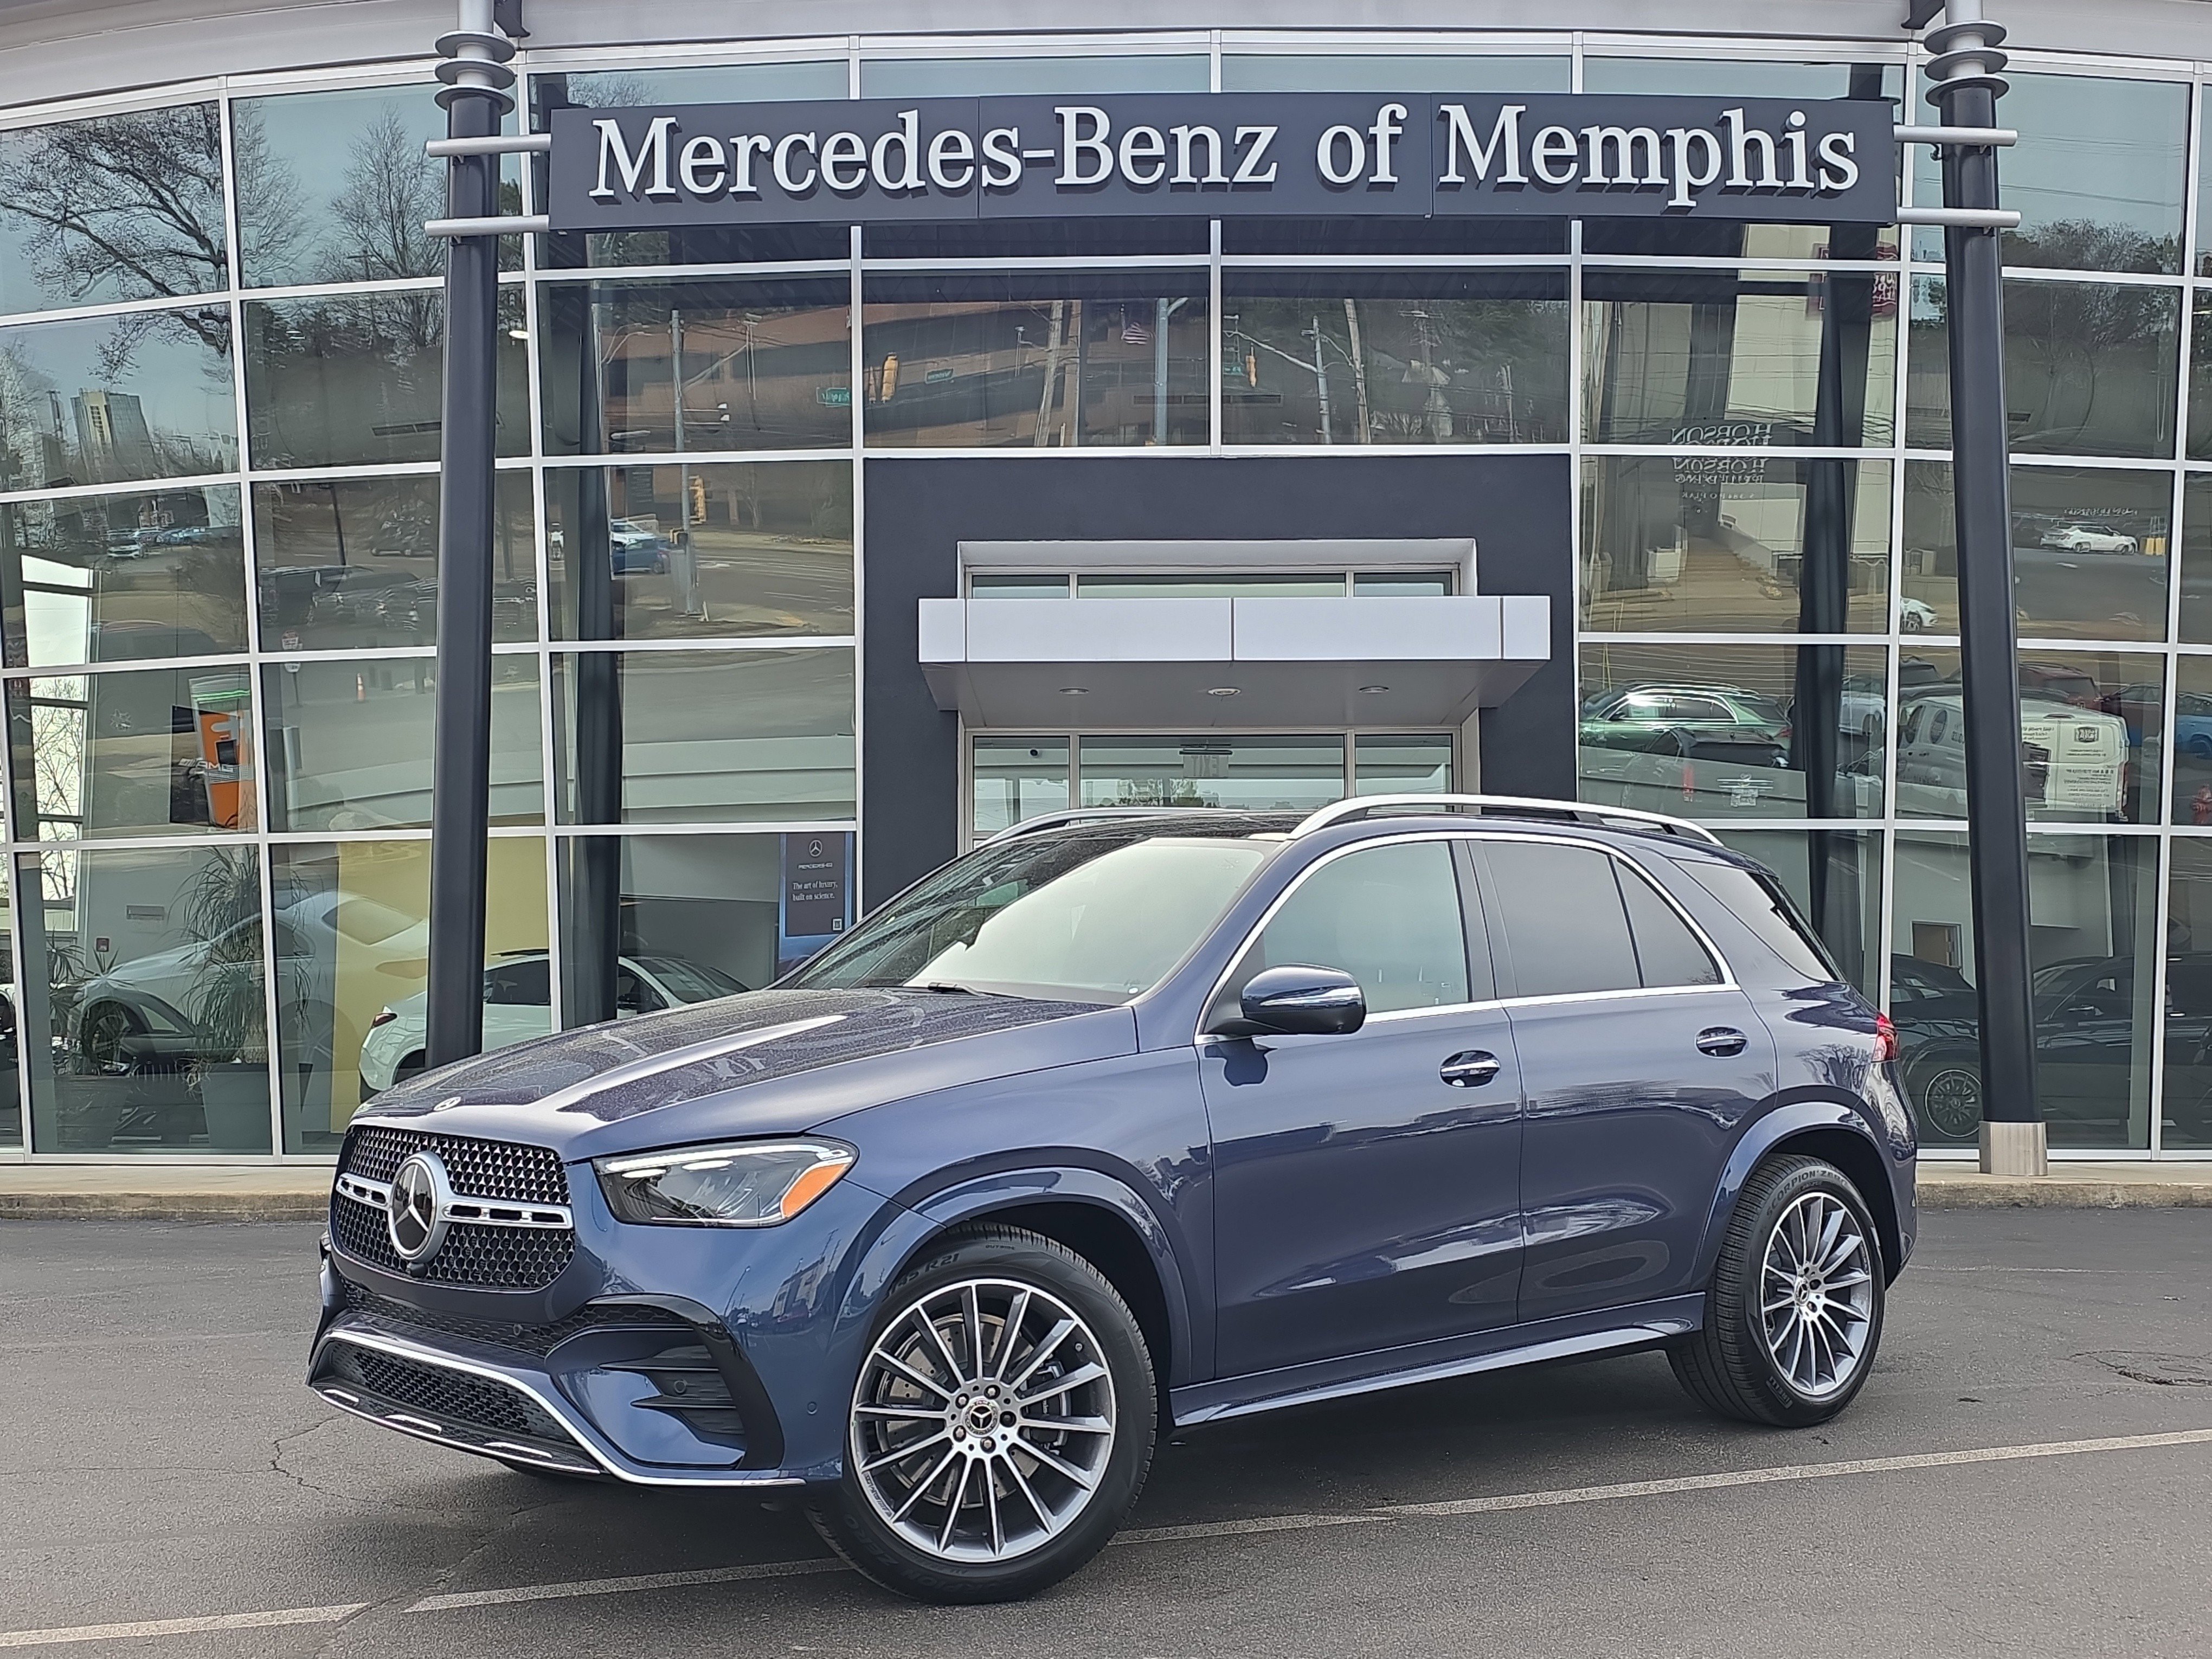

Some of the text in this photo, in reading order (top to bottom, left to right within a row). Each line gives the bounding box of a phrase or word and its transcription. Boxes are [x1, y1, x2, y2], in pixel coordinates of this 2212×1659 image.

[589, 104, 1860, 208] Mercedes-Benz of Memphis
[196, 761, 234, 773] AMG
[1766, 1169, 1848, 1216] SCORPION ZERO
[924, 1252, 960, 1273] R21
